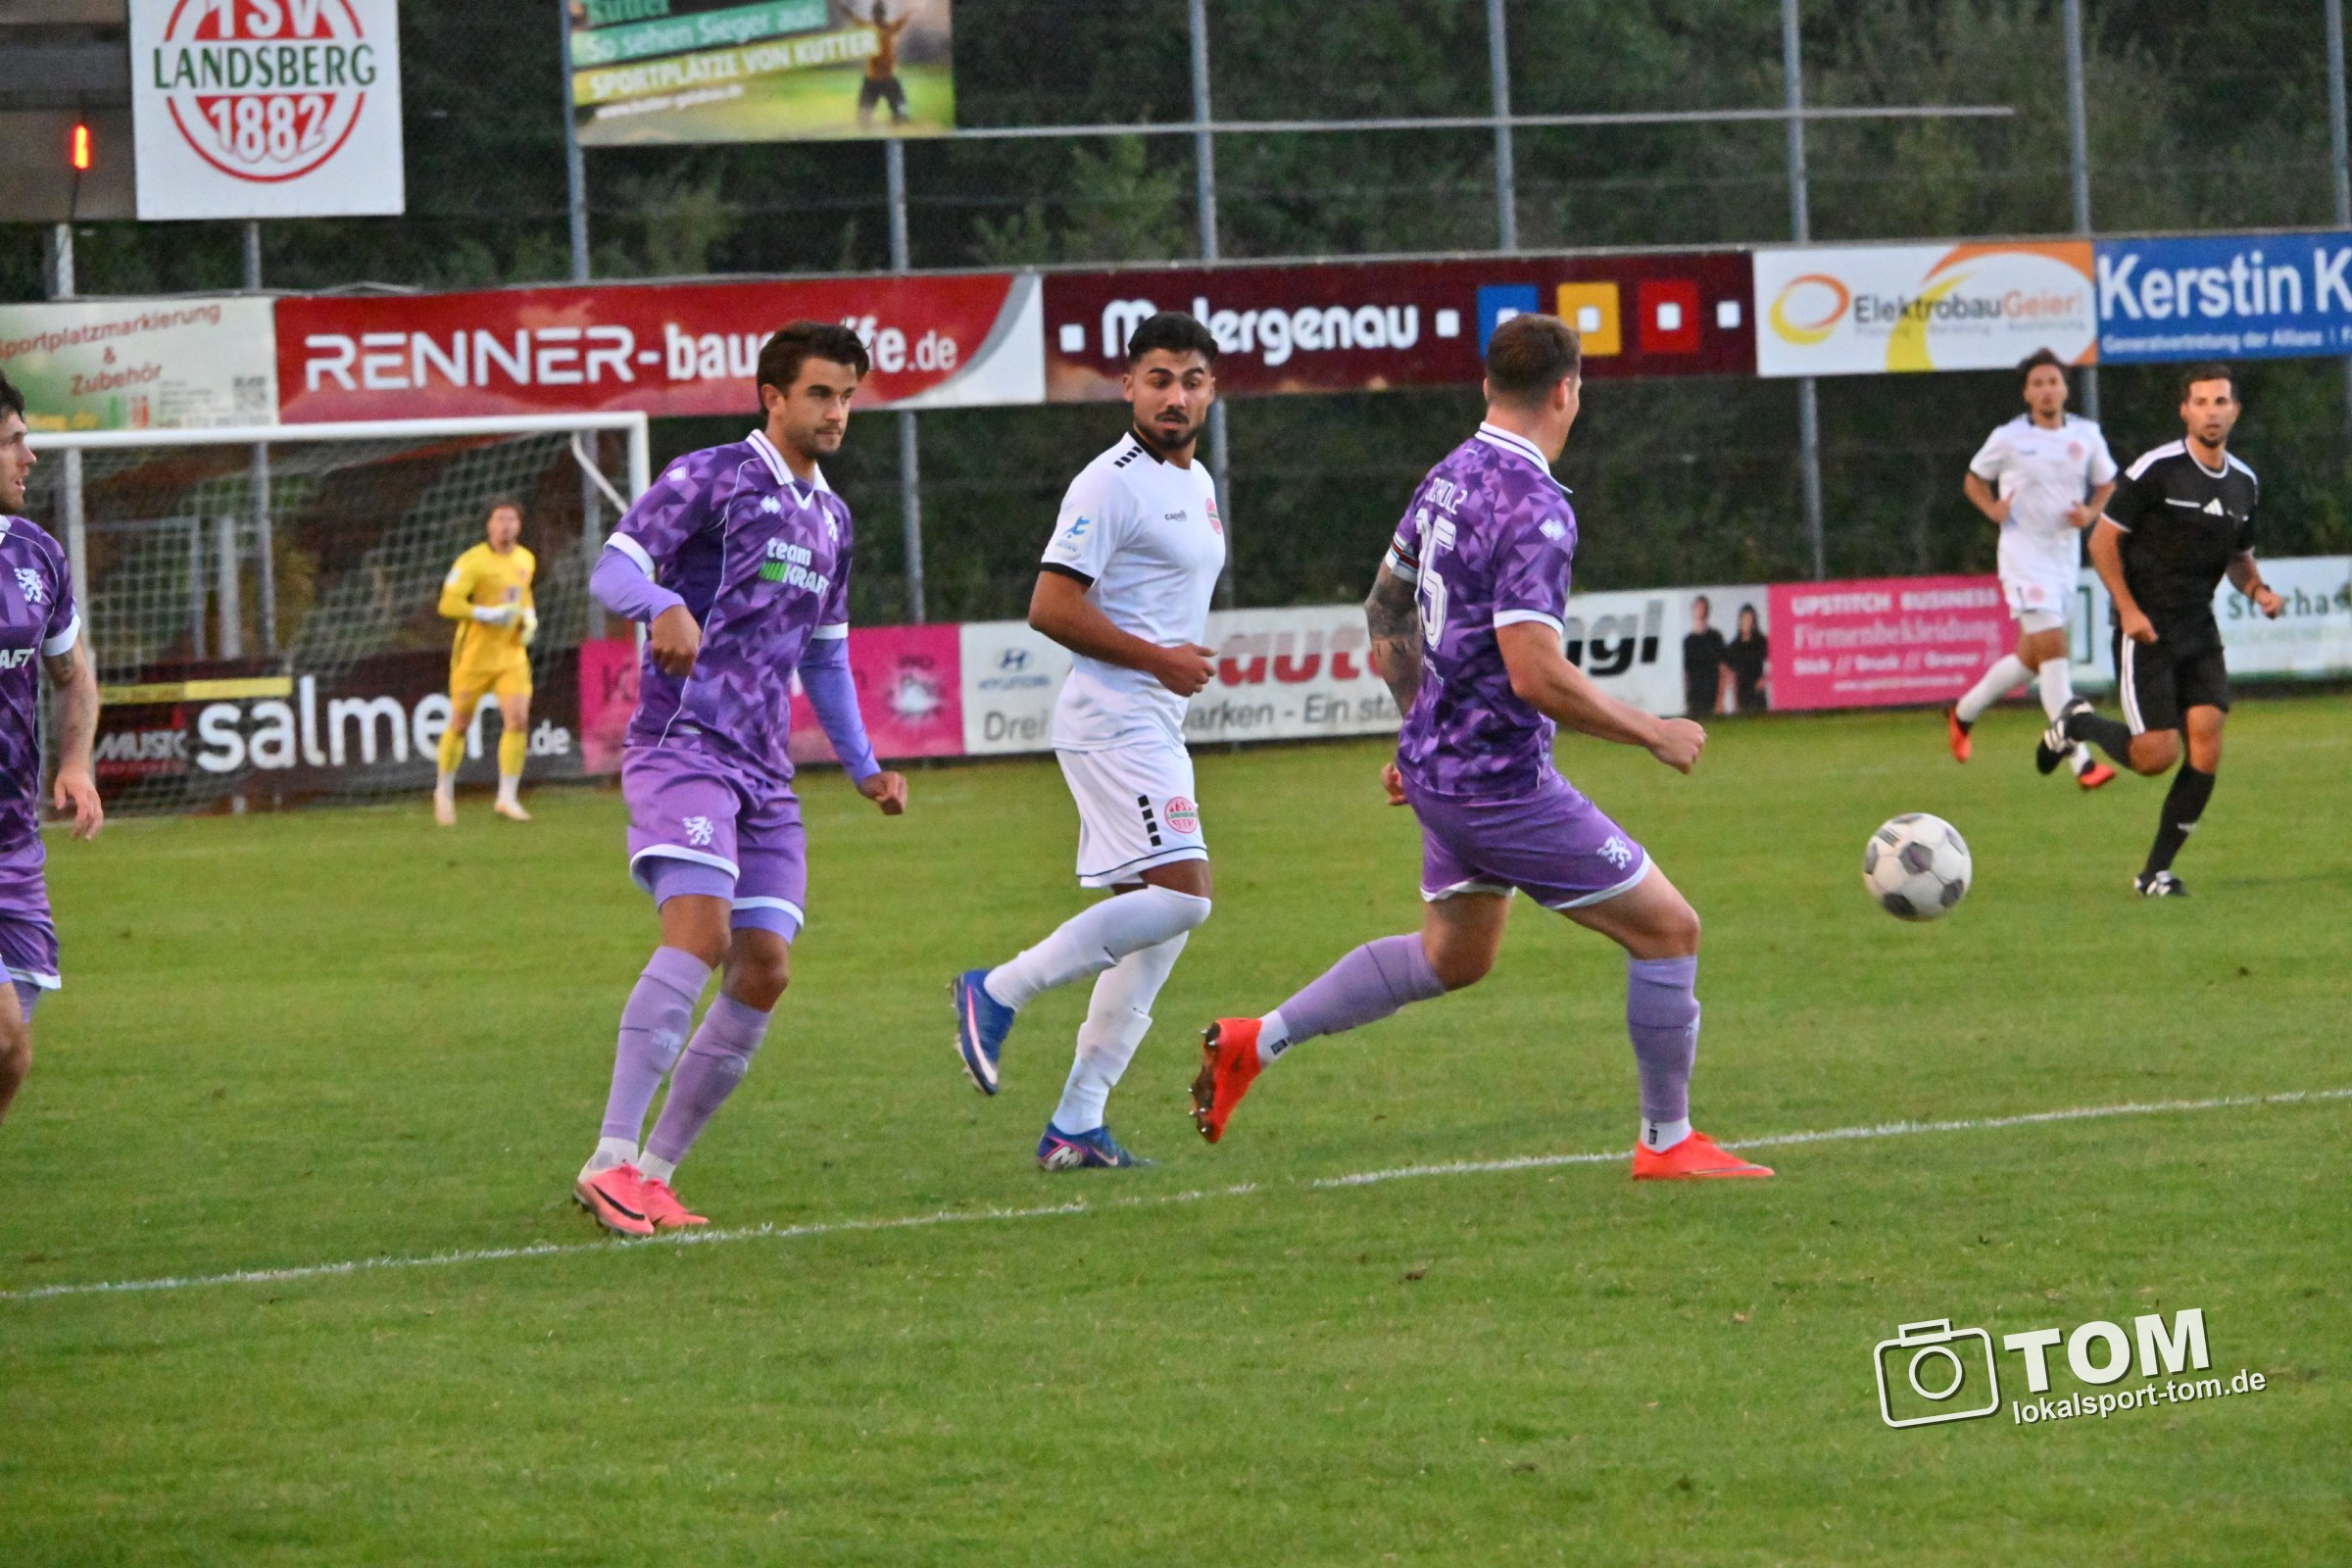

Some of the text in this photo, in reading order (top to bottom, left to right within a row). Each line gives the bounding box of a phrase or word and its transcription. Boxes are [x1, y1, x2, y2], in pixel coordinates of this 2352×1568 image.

[698, 15, 770, 44] Sieger
[153, 44, 376, 89] LANDSBERG
[742, 45, 790, 73] VON
[795, 30, 879, 63] KUTTER
[209, 96, 326, 164] 1882
[2097, 247, 2352, 320] Kerstin K
[0, 305, 220, 361] portplatzmarkierung
[1102, 295, 1419, 367] Mlergenau
[2242, 330, 2269, 349] der
[2272, 326, 2323, 348] Allianz
[103, 345, 117, 366] &
[71, 364, 162, 395] Zubehör
[767, 537, 811, 566] team
[1900, 588, 1998, 611] BUSINESS
[984, 707, 1050, 742] Drei
[1190, 699, 1274, 731] arken
[1304, 694, 1348, 724] Ein
